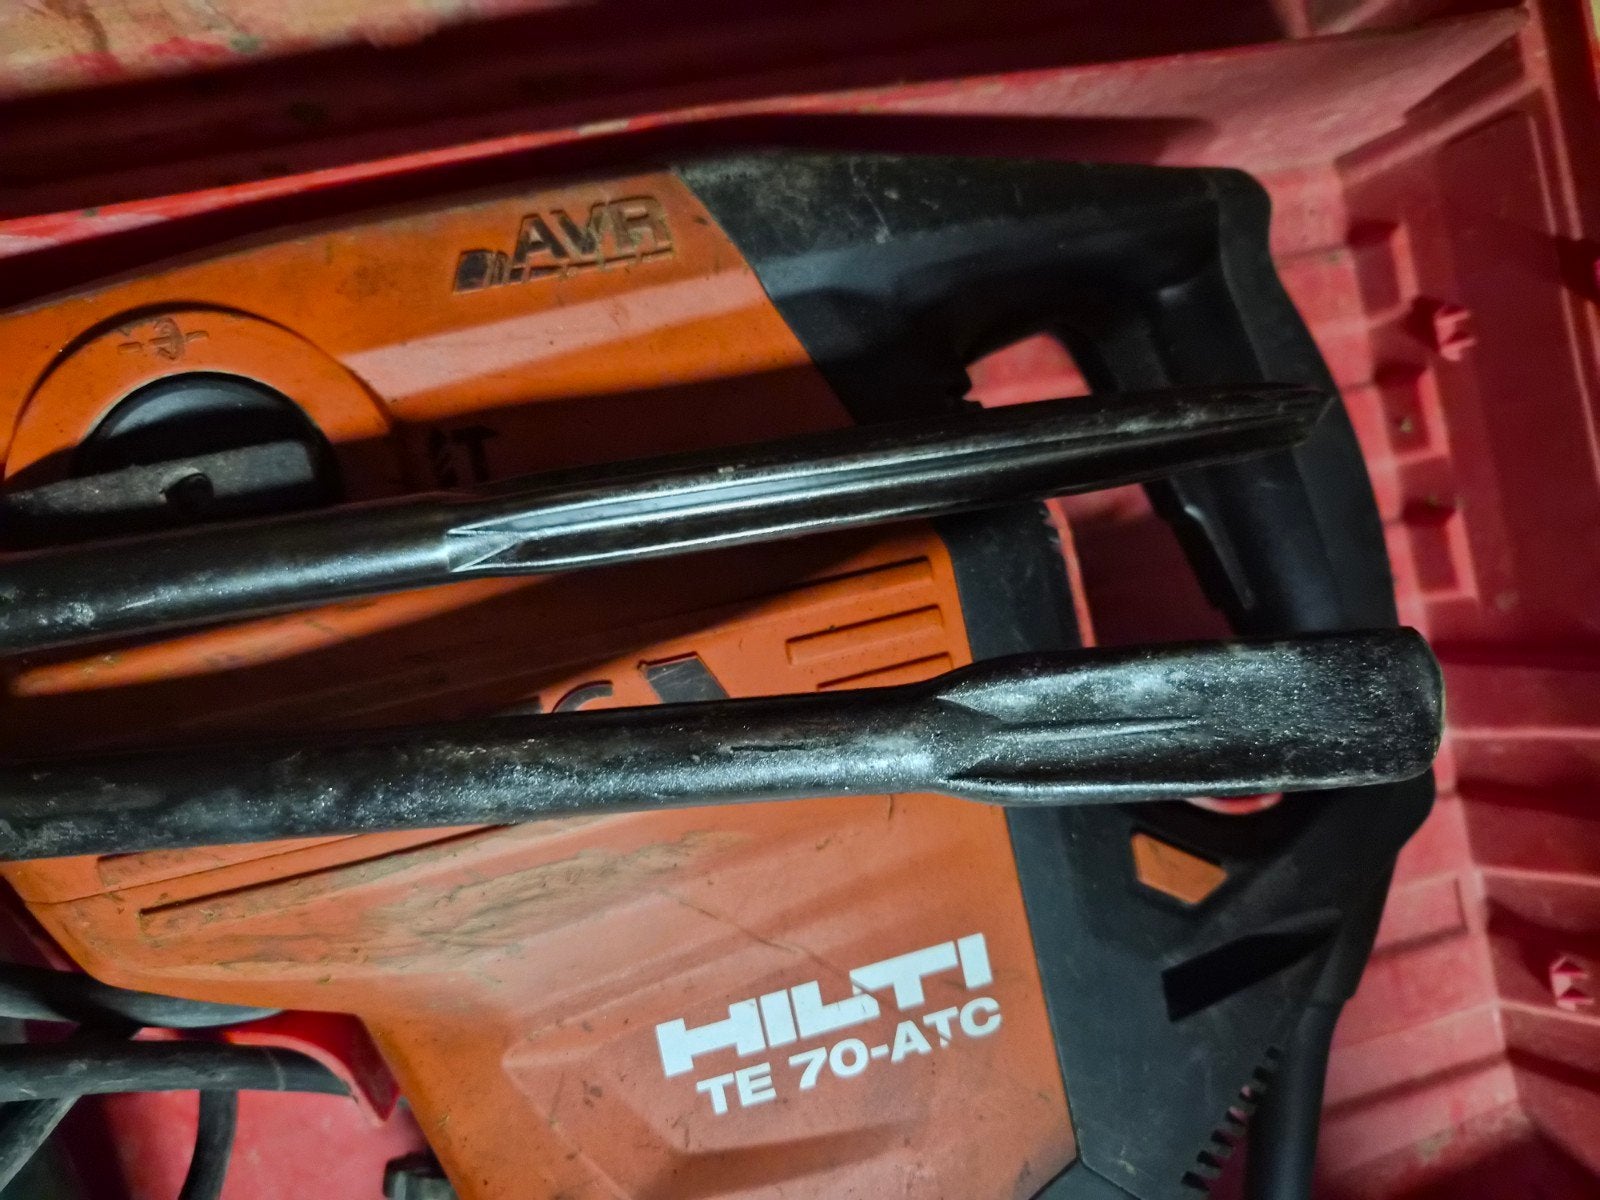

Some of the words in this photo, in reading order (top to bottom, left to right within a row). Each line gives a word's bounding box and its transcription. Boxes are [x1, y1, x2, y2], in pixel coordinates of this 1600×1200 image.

[512, 194, 674, 268] AVR
[656, 932, 993, 1078] HILTI
[696, 1062, 777, 1116] TE
[788, 997, 1003, 1090] 70-ATC
